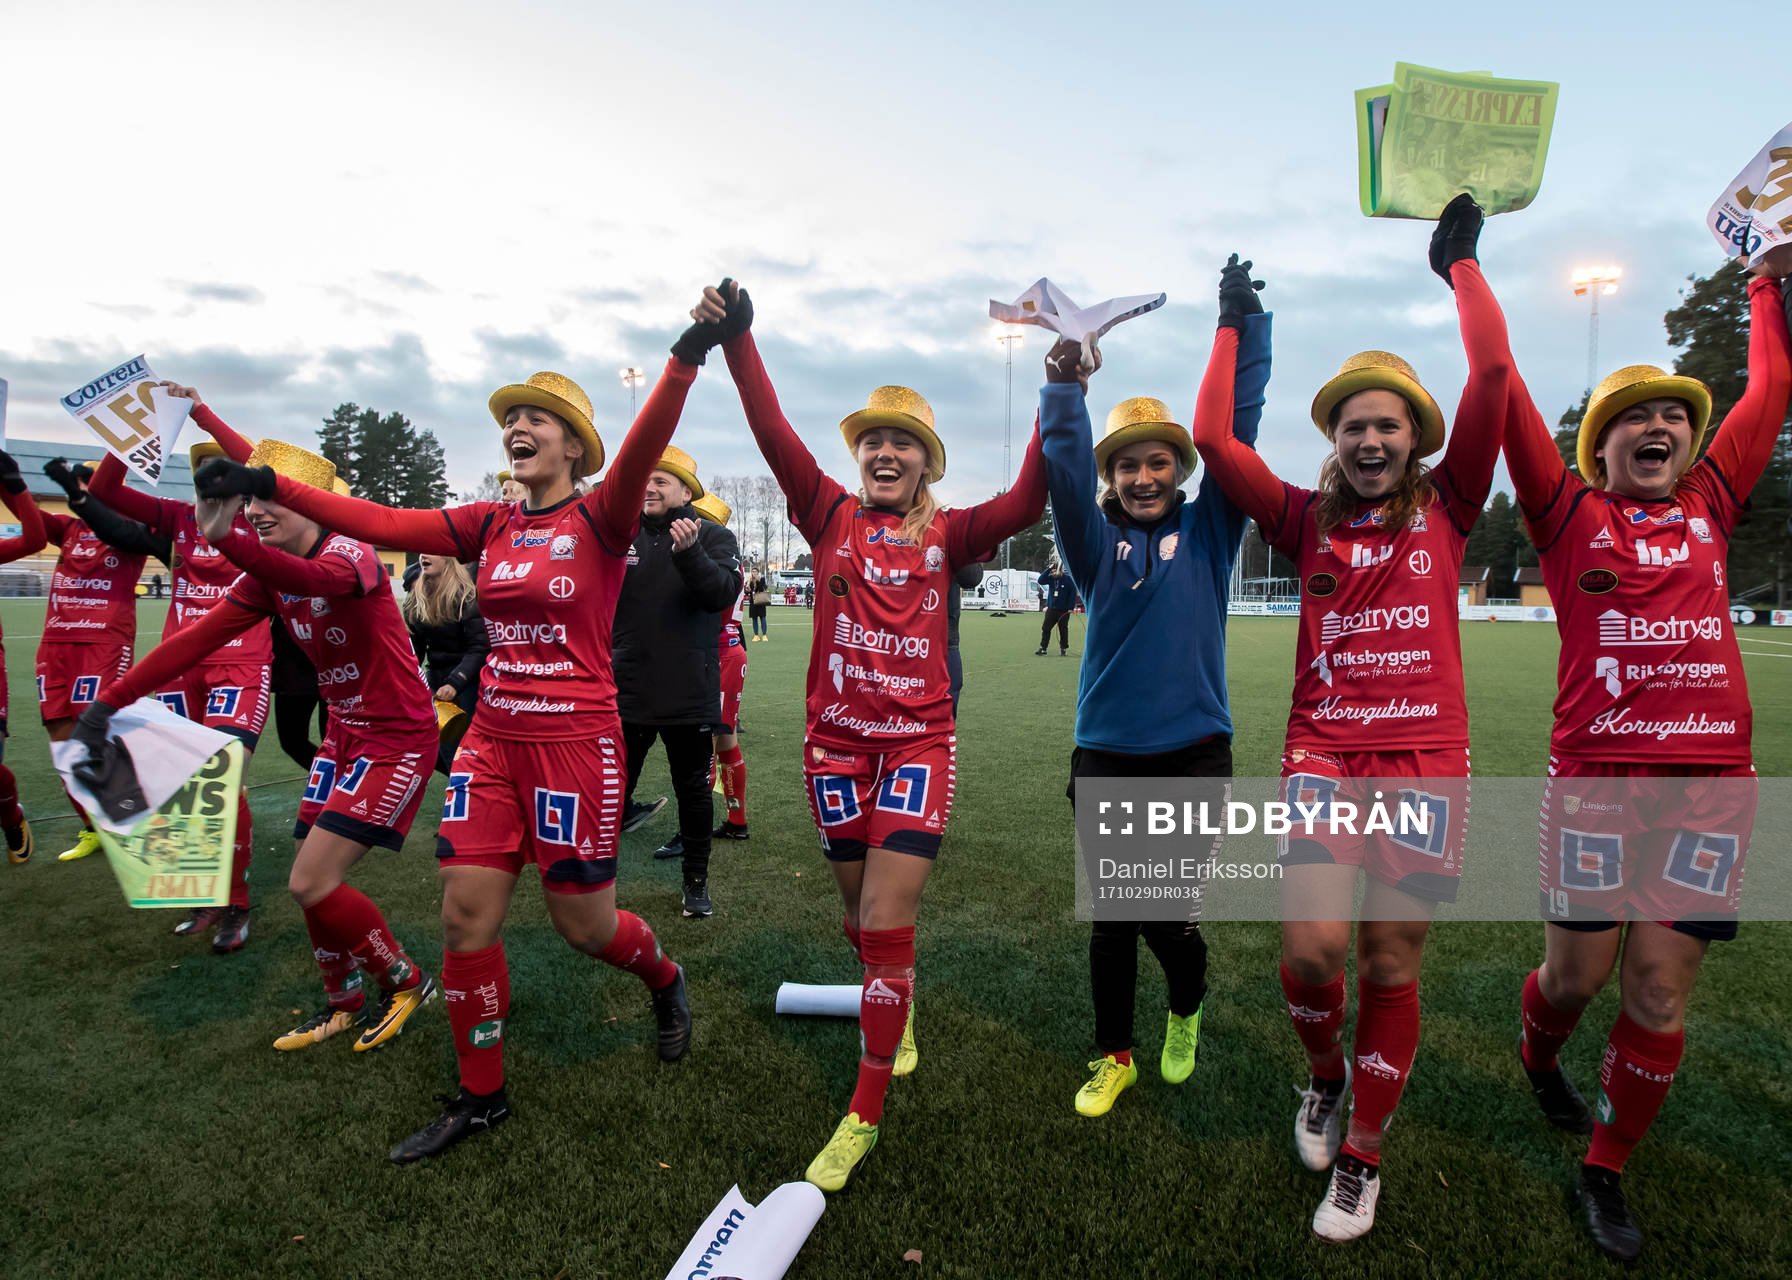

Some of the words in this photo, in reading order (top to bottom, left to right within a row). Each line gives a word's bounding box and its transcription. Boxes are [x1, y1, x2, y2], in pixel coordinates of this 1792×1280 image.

[64, 359, 145, 408] Corren
[1589, 541, 1615, 549] SELECT
[63, 577, 112, 590] Botrygg
[496, 621, 567, 645] Botrygg
[852, 623, 930, 658] Botrygg
[1630, 615, 1722, 640] Botrygg
[1332, 650, 1430, 667] Riksbyggen
[846, 664, 925, 689] Riksbyggen
[1347, 668, 1370, 680] Rum
[1371, 666, 1385, 678] för
[1387, 665, 1407, 676] hela
[482, 685, 576, 716] Korvgubbens
[1312, 695, 1438, 725] Korvgubbens
[821, 703, 927, 736] Korvgubbens
[1590, 707, 1736, 741] Korvgubbens
[1548, 887, 1569, 917] 19
